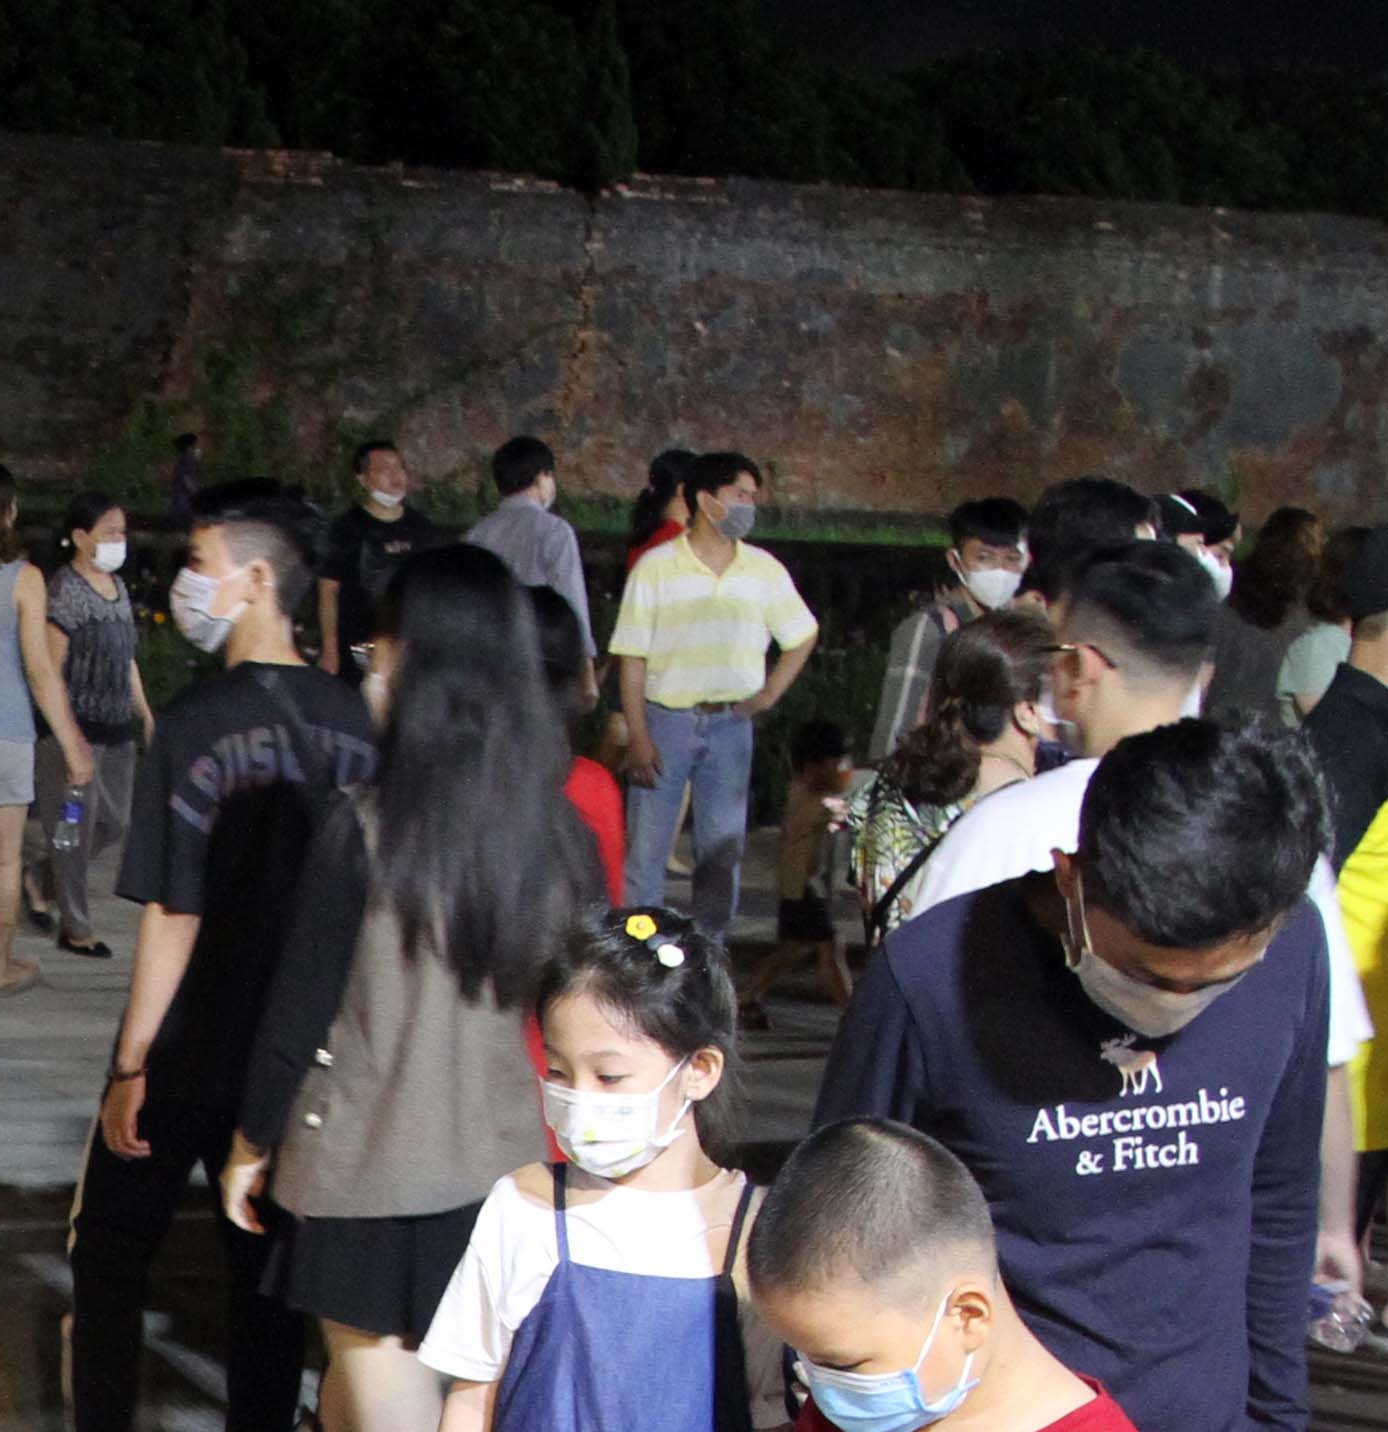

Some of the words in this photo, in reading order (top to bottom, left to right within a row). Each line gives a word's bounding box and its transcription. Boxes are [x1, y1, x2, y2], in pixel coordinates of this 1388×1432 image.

[1026, 1087, 1246, 1143] Abercrombie
[1075, 1150, 1104, 1176] &
[1112, 1130, 1200, 1172] Fitch
